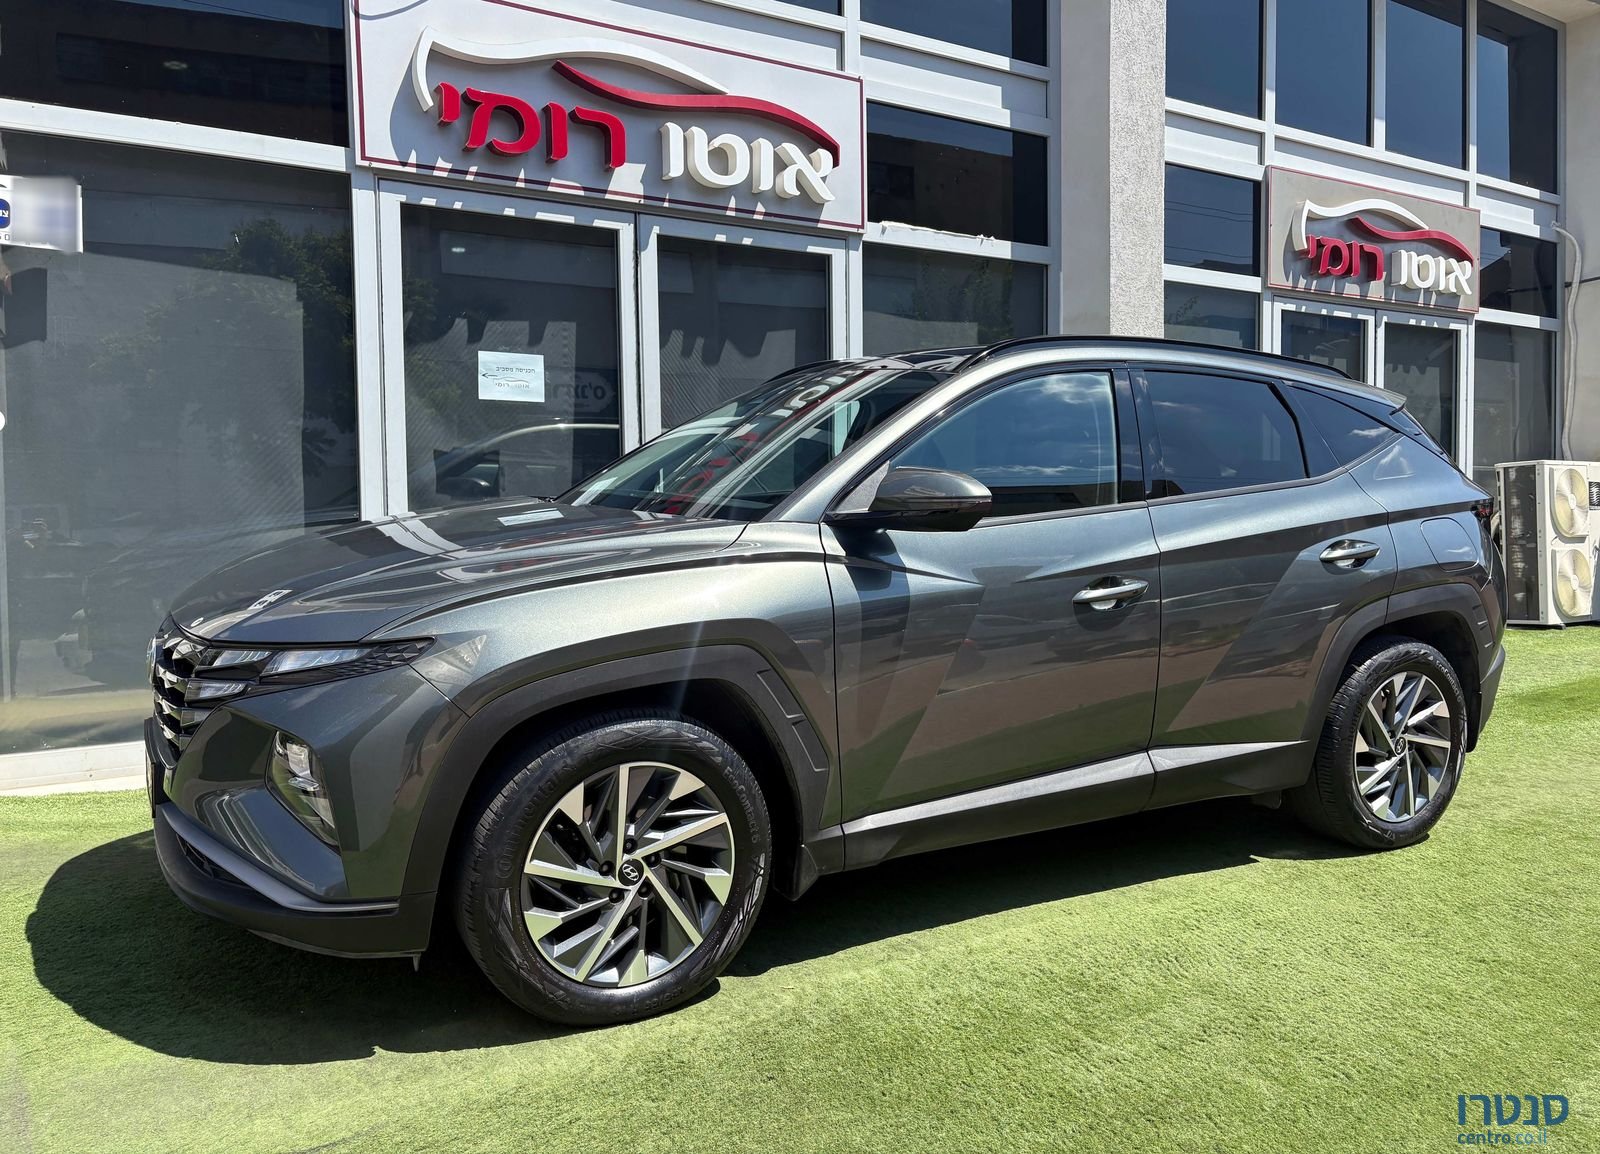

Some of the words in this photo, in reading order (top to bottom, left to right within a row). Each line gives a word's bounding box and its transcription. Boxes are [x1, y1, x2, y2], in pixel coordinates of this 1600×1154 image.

[435, 81, 627, 171] רומי
[659, 121, 836, 204] אוטו
[1301, 234, 1385, 282] רומי
[1393, 250, 1473, 296] אוטו
